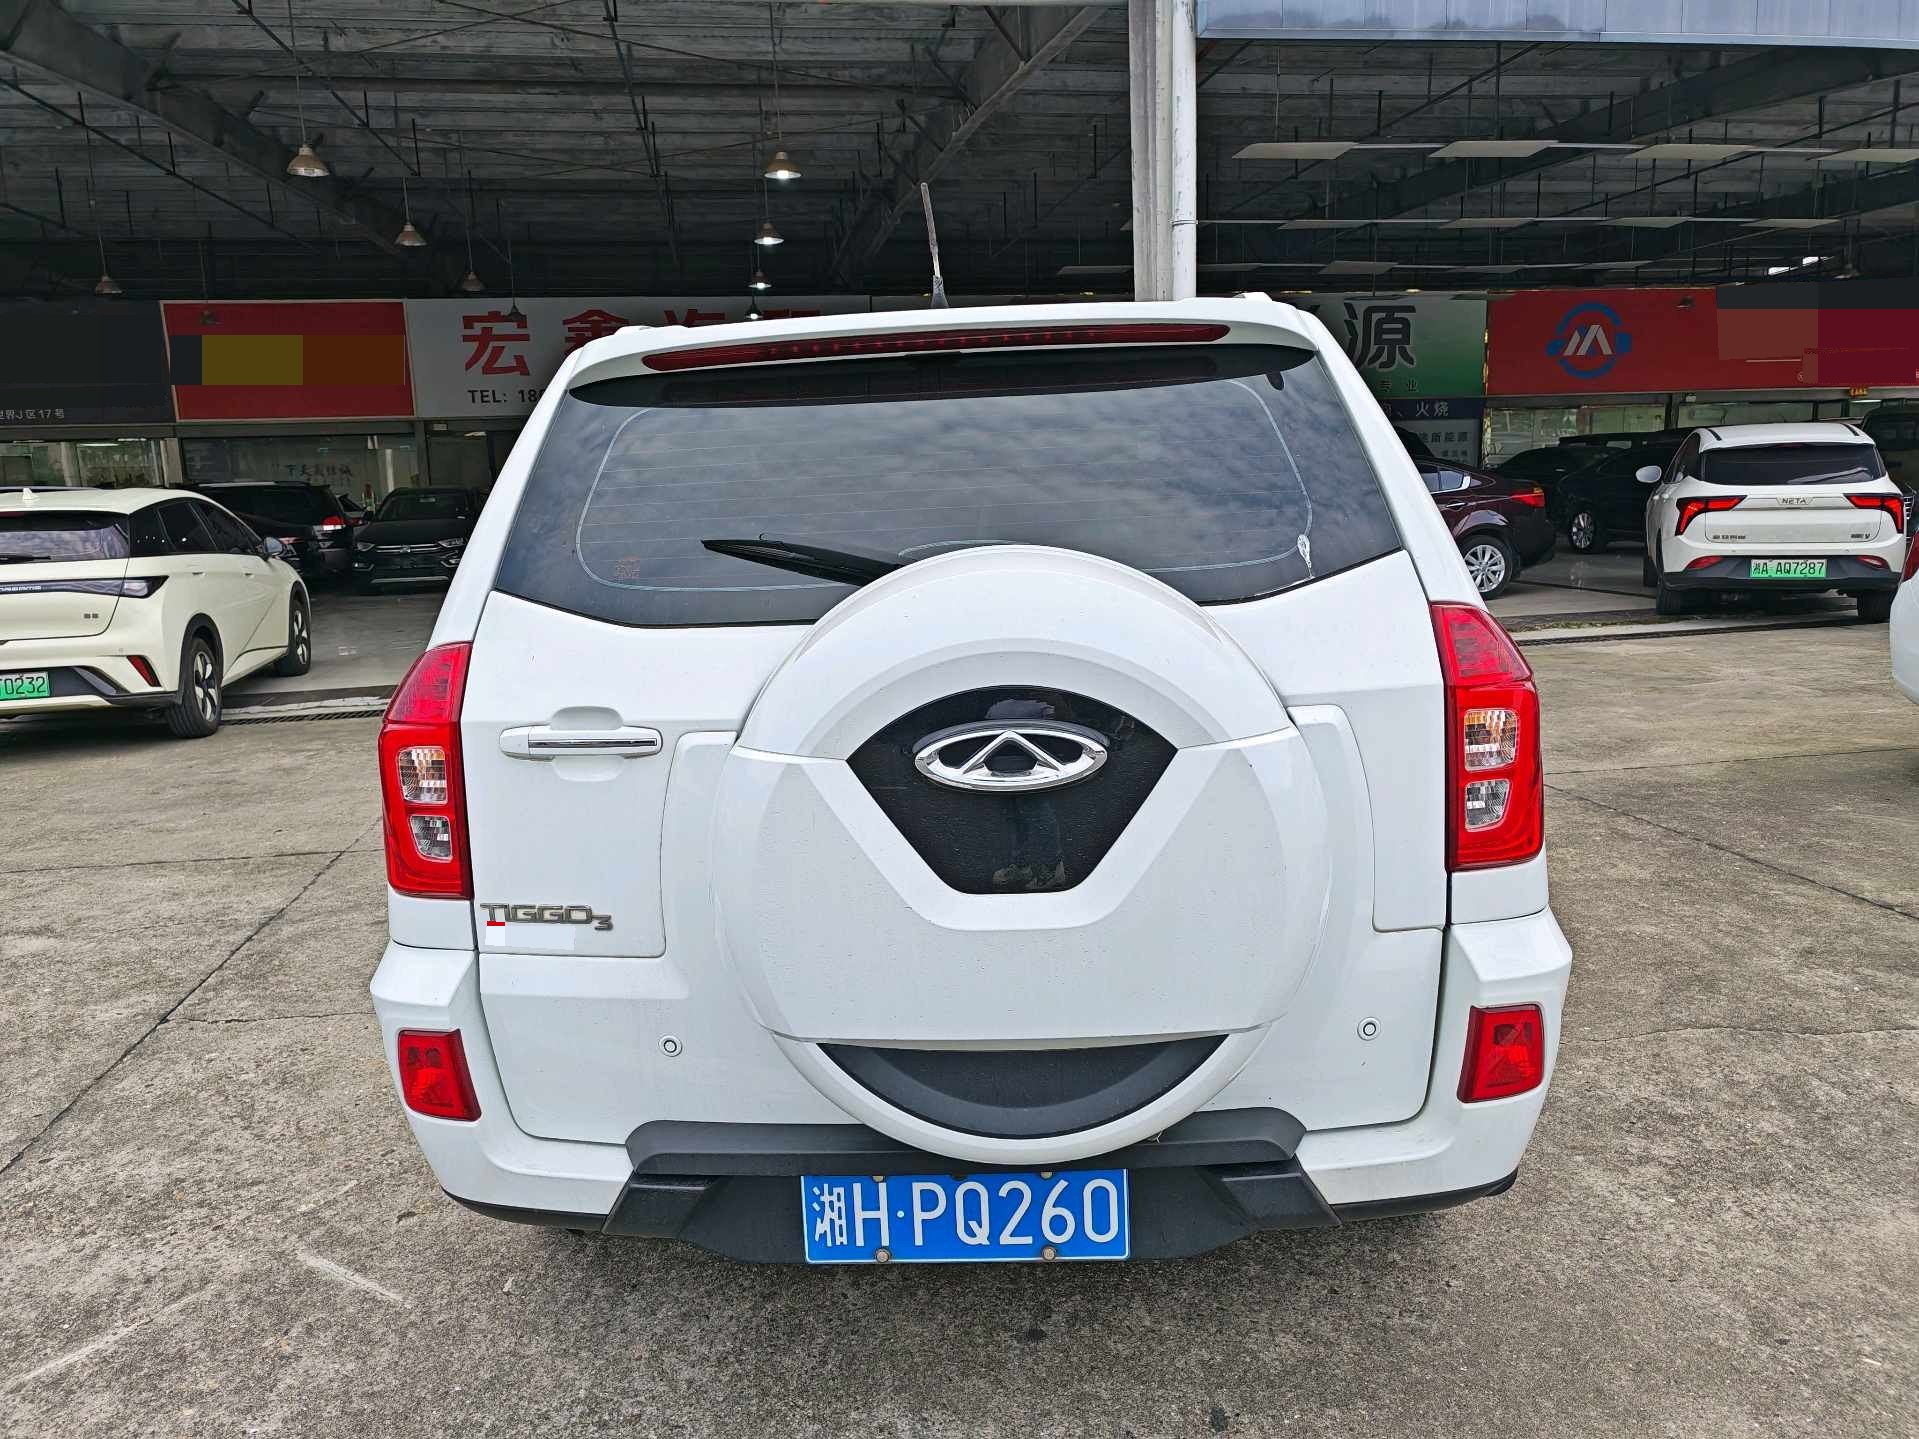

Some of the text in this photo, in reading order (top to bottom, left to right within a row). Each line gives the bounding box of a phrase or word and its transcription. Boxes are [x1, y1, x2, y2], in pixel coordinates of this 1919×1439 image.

[468, 389, 508, 404] TEL:
[1781, 496, 1807, 505] NETA
[1775, 561, 1825, 575] AQ7287
[0, 676, 47, 696] 0232
